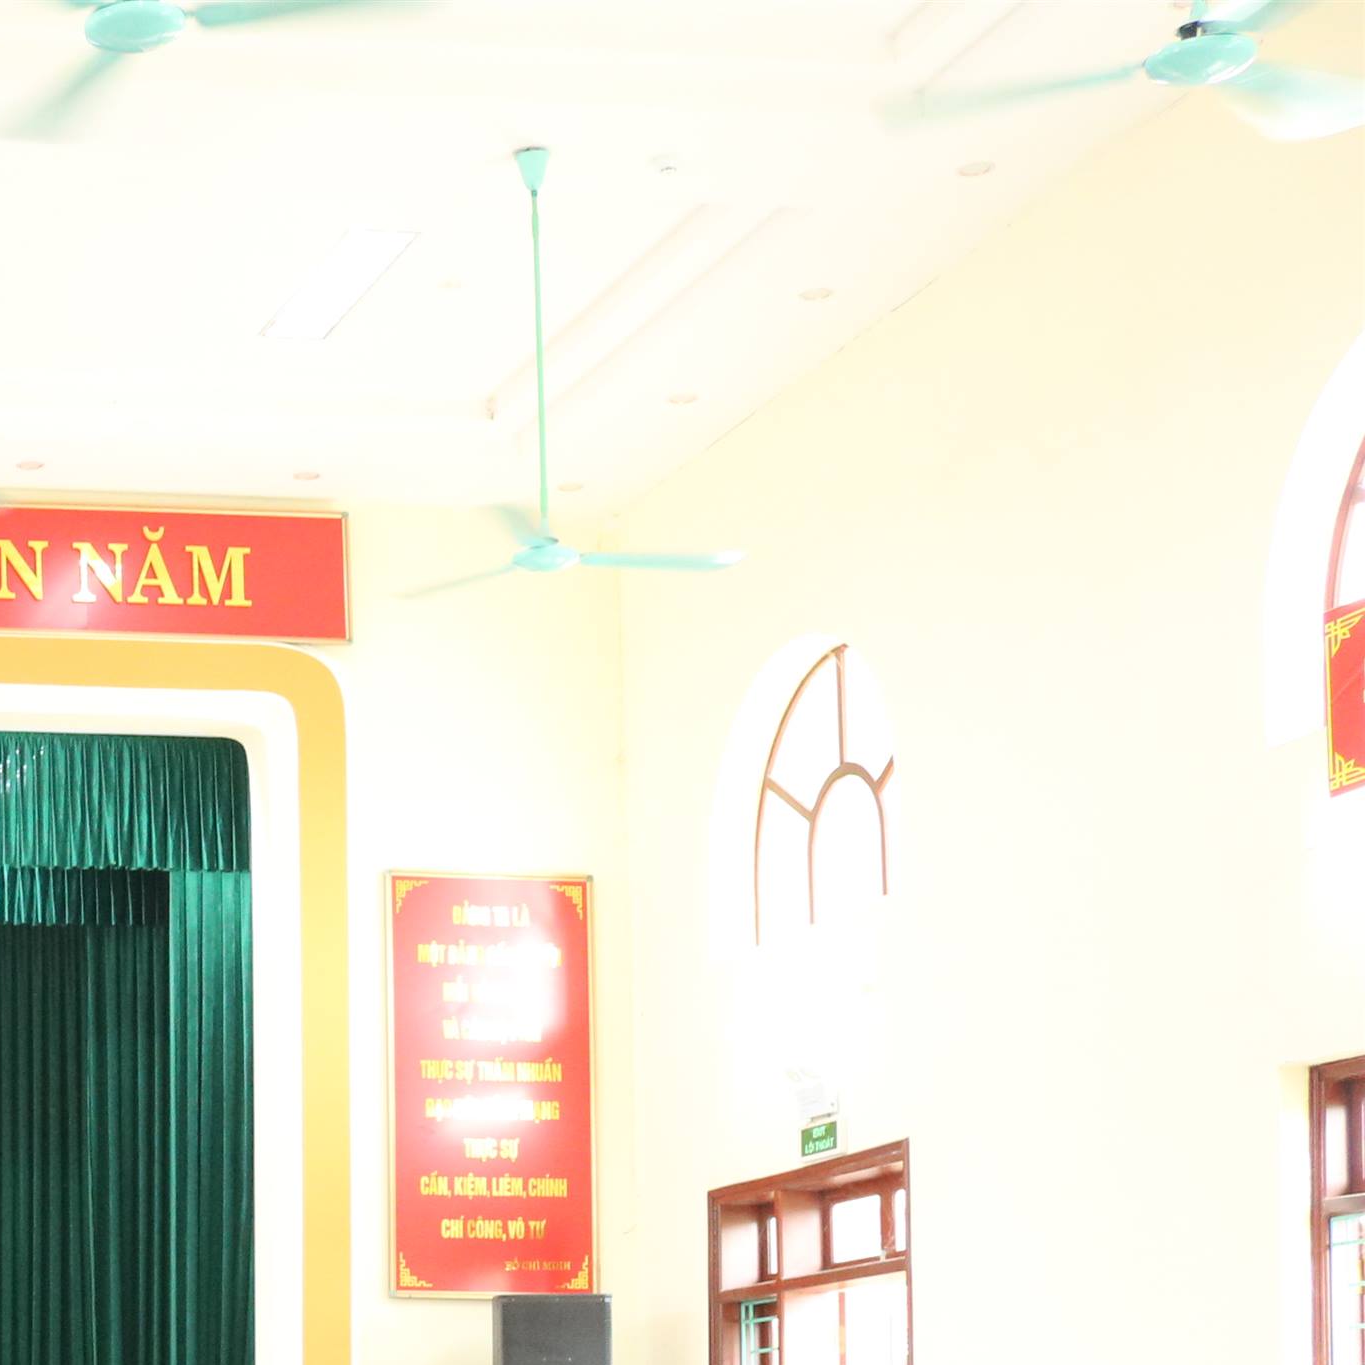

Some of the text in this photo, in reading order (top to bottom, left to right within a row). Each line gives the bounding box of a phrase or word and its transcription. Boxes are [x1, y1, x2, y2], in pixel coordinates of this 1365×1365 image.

[72, 525, 253, 608] NĂM
[420, 1059, 454, 1084] THỰC
[528, 1174, 568, 1198] CHÍNH
[441, 1215, 464, 1239] CHÍ
[507, 1217, 525, 1239] VÔ
